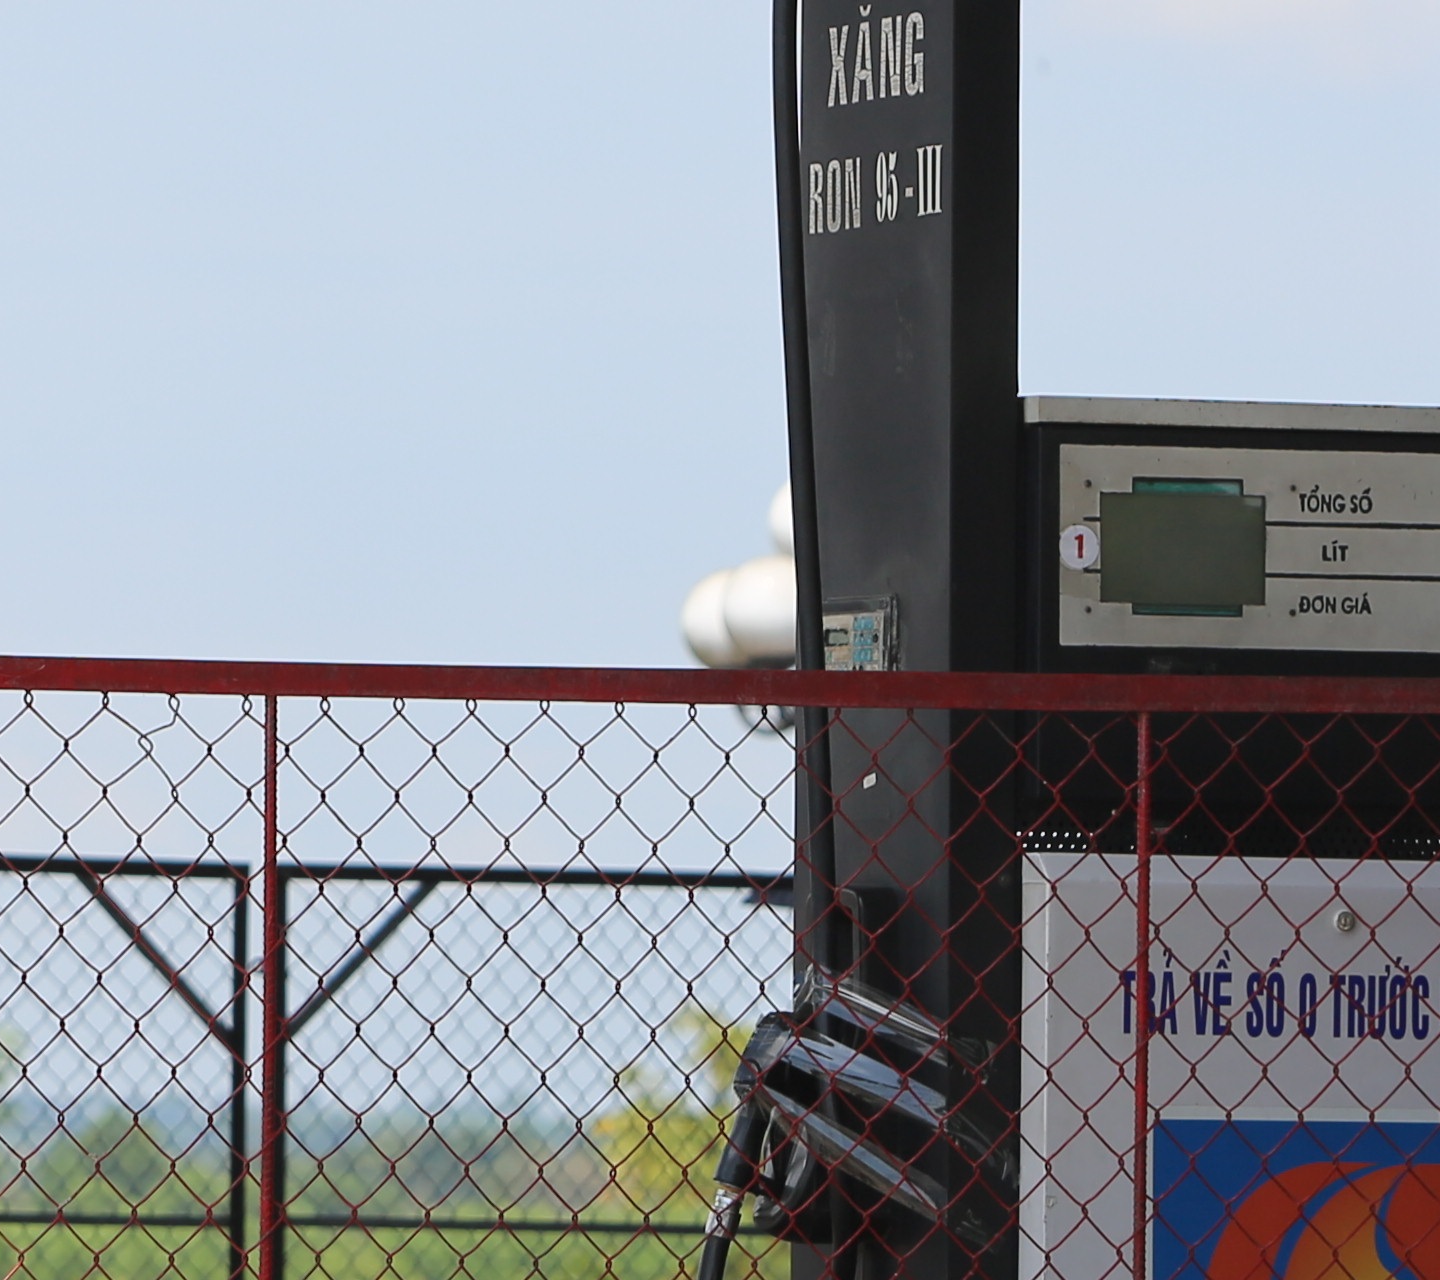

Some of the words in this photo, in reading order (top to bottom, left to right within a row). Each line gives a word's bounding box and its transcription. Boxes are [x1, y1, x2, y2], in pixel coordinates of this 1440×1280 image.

[826, 4, 926, 108] XĂNG
[808, 158, 863, 236] RON
[1298, 484, 1346, 514] TỔNG
[1349, 487, 1373, 514] SỐ
[1074, 533, 1085, 559] 1
[1321, 539, 1349, 562] LÍT
[1298, 594, 1337, 614] ĐƠN
[1340, 591, 1372, 615] GIÁ
[1193, 950, 1233, 1035] VỀ
[1246, 948, 1286, 1038] SỐ
[1330, 955, 1429, 1040] TRƯỚC
